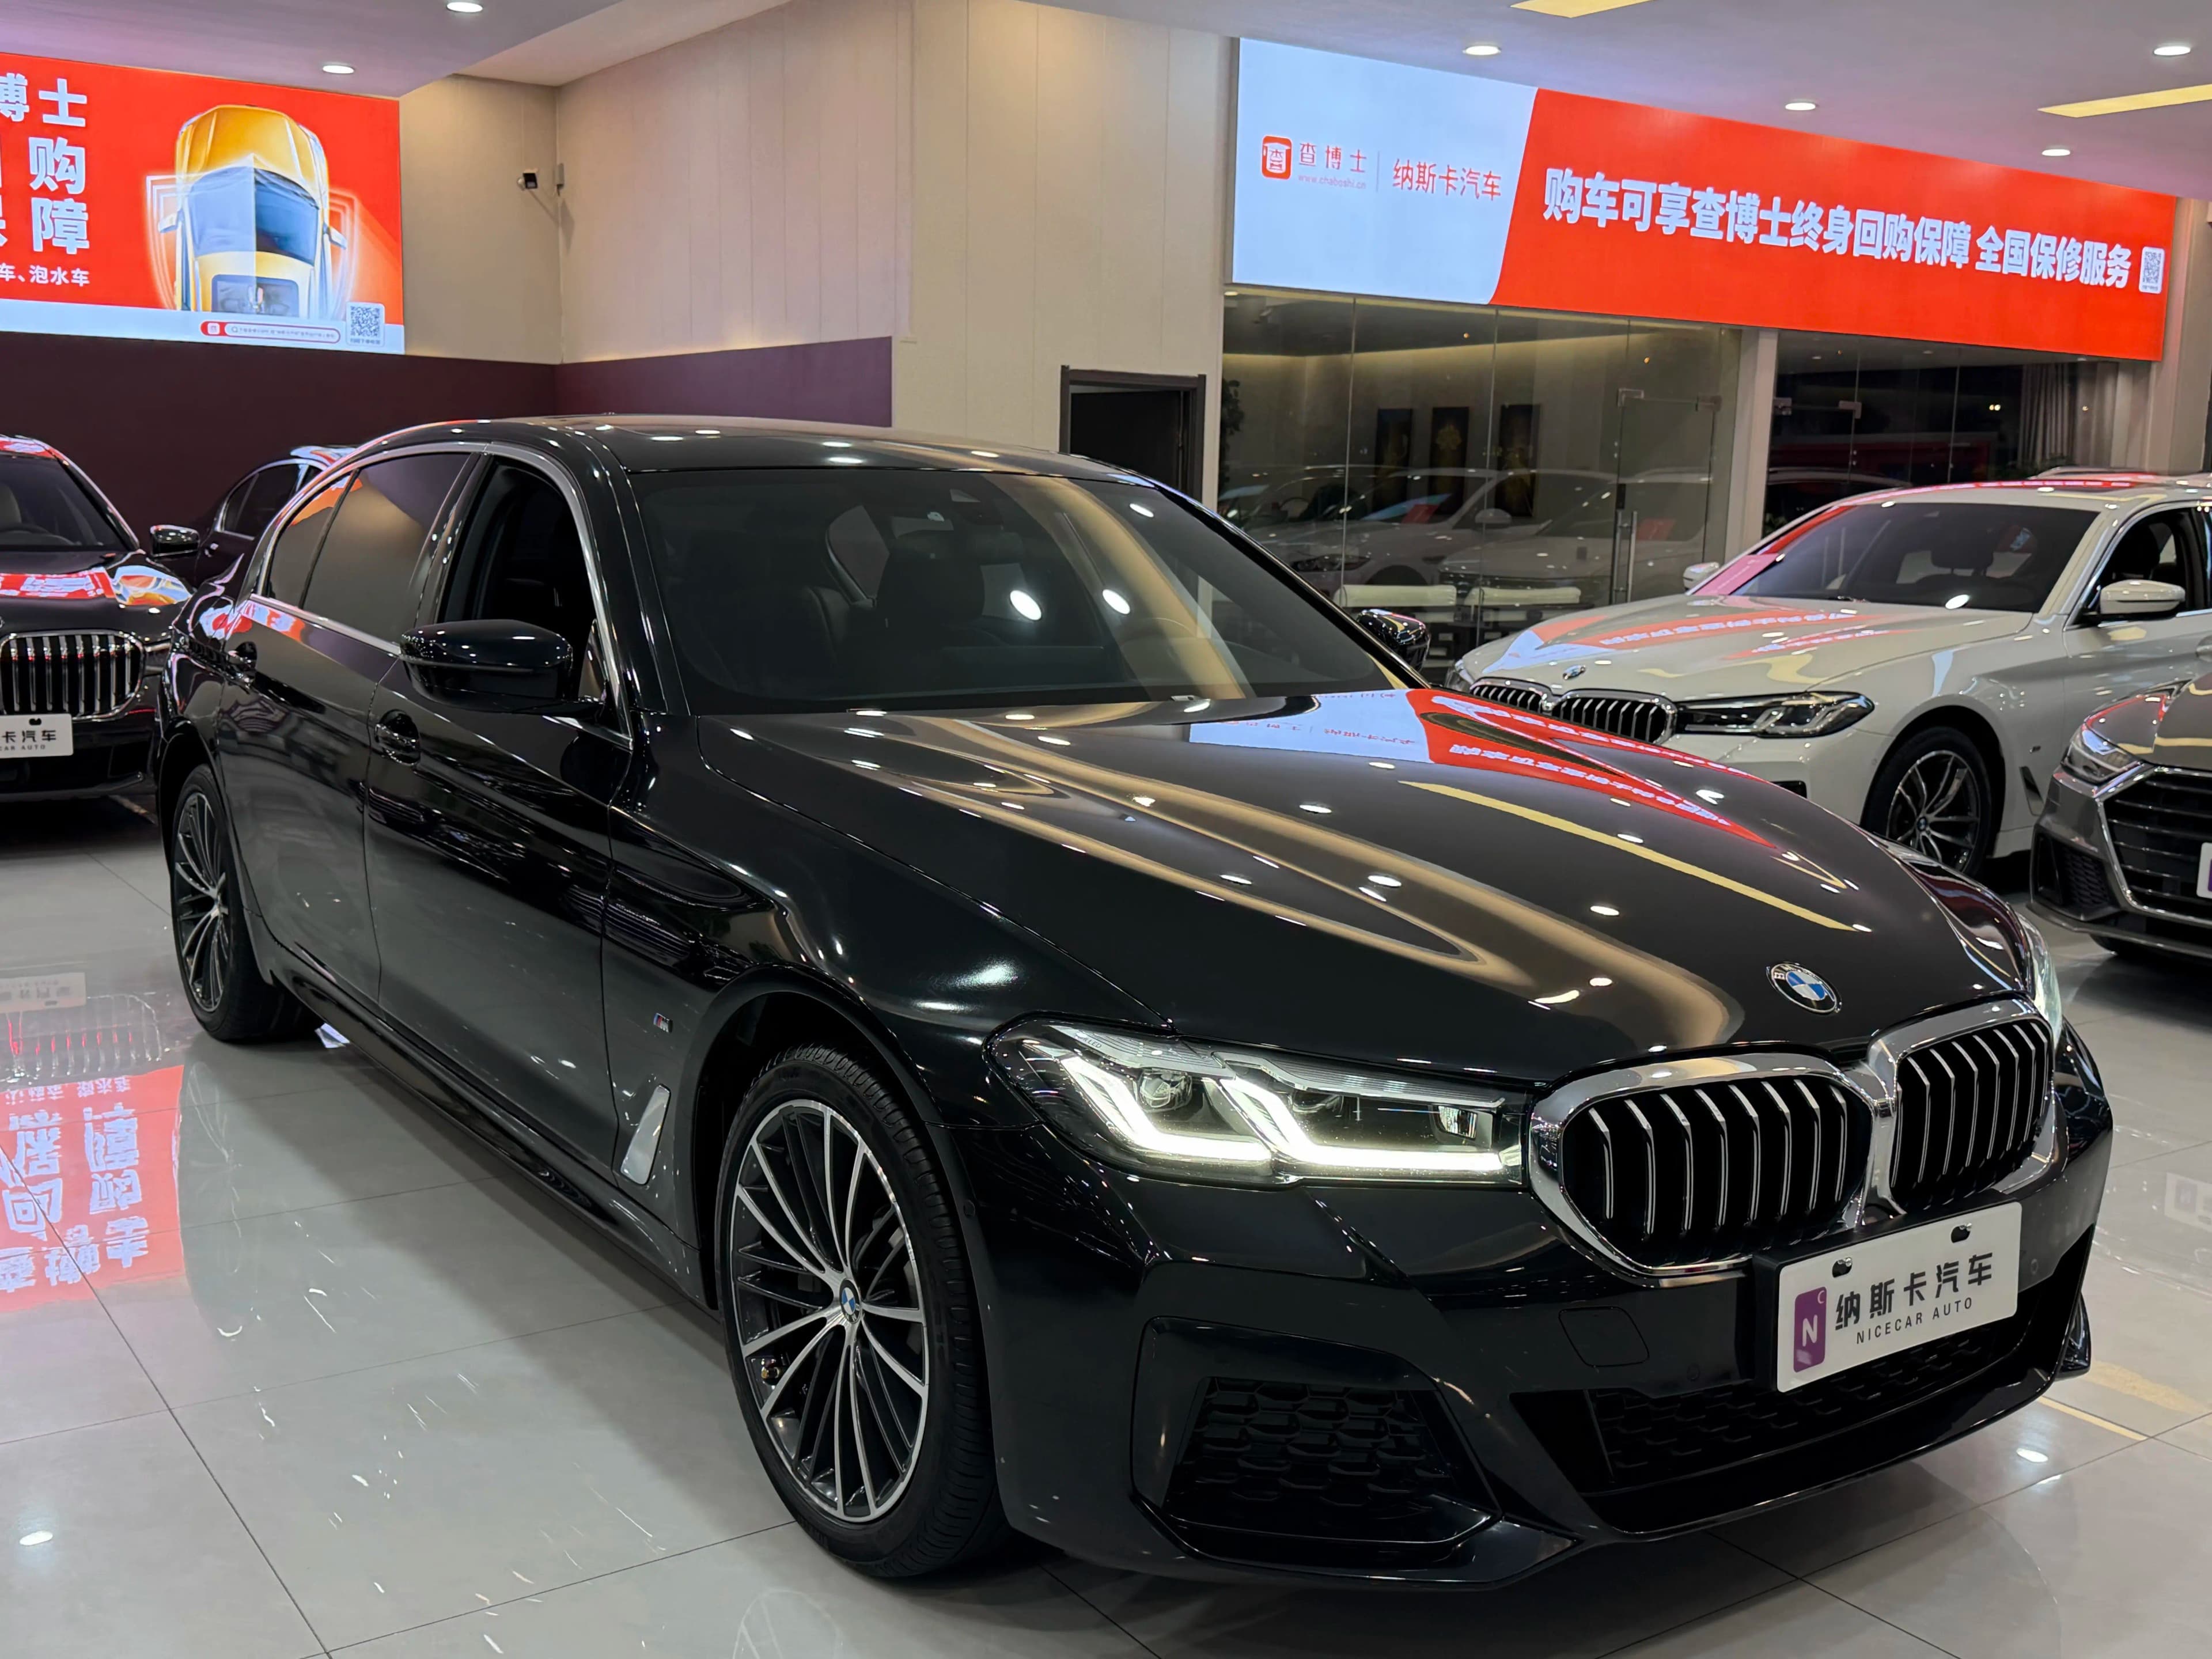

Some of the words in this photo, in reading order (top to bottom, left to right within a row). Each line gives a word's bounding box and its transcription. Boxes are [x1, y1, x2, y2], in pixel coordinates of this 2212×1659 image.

[0, 135, 86, 195] 购
[1299, 142, 1367, 173] 查博士
[1393, 158, 1502, 200] 纳斯卡汽车
[0, 195, 90, 255] 障
[1543, 168, 1971, 269] 购车可享查博士终身回购保障
[1975, 225, 2132, 289] 全国保修服务
[0, 262, 90, 287] 车、泡水车
[1, 730, 57, 744] 卡汽车
[1835, 1252, 1993, 1331] 纳斯卡汽车
[1856, 1312, 1923, 1344] NICECAR
[1932, 1297, 1972, 1320] AUTO
